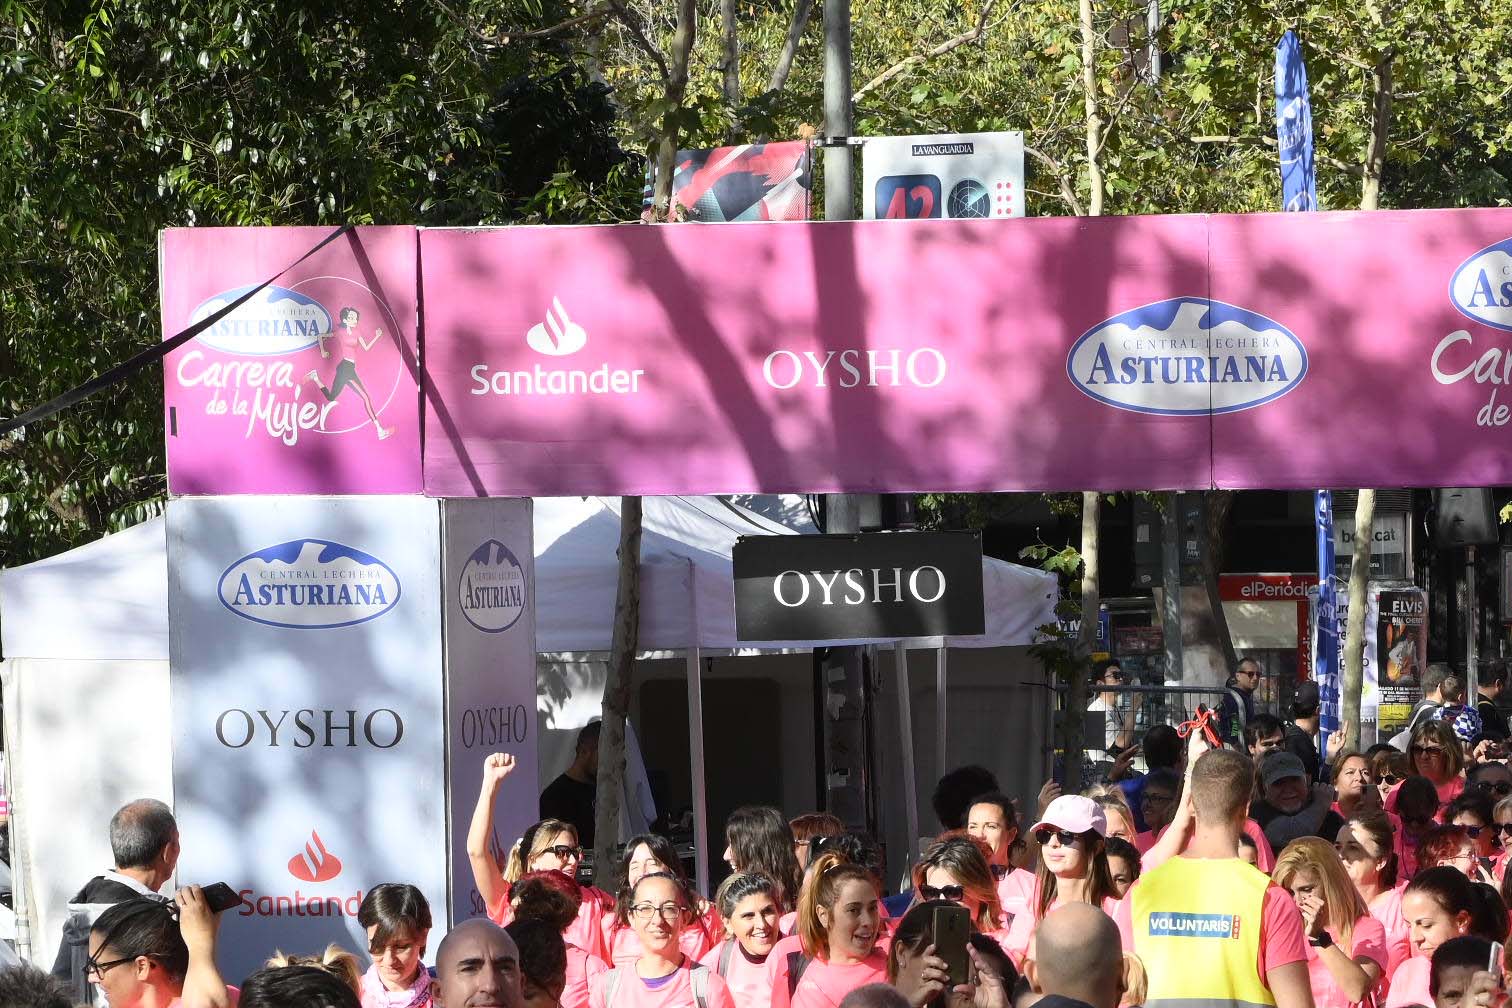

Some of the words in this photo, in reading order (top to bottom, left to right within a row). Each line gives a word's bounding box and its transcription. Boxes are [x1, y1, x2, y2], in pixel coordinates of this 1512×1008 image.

[1123, 339, 1197, 350] CENTRAL
[1206, 337, 1280, 349] LECHERA
[176, 350, 294, 388] Carrera
[471, 364, 645, 396] Santander
[762, 347, 946, 390] OYSHO
[1085, 341, 1289, 385] ASTURIANA
[205, 387, 229, 416] de
[232, 386, 248, 416] la
[245, 384, 339, 446] Mujer
[1477, 397, 1511, 427] de
[232, 572, 388, 607] ASTURIANA
[260, 570, 315, 580] CENTRAL
[324, 568, 381, 579] LECHERA
[773, 565, 947, 608] OYSHO
[464, 575, 523, 610] ASTURIANA
[1392, 600, 1424, 613] ELVIS
[215, 707, 405, 749] OYSHO
[461, 704, 528, 749] OYSHO
[238, 888, 361, 917] Santand
[1150, 918, 1231, 933] VOLUNTARIS
